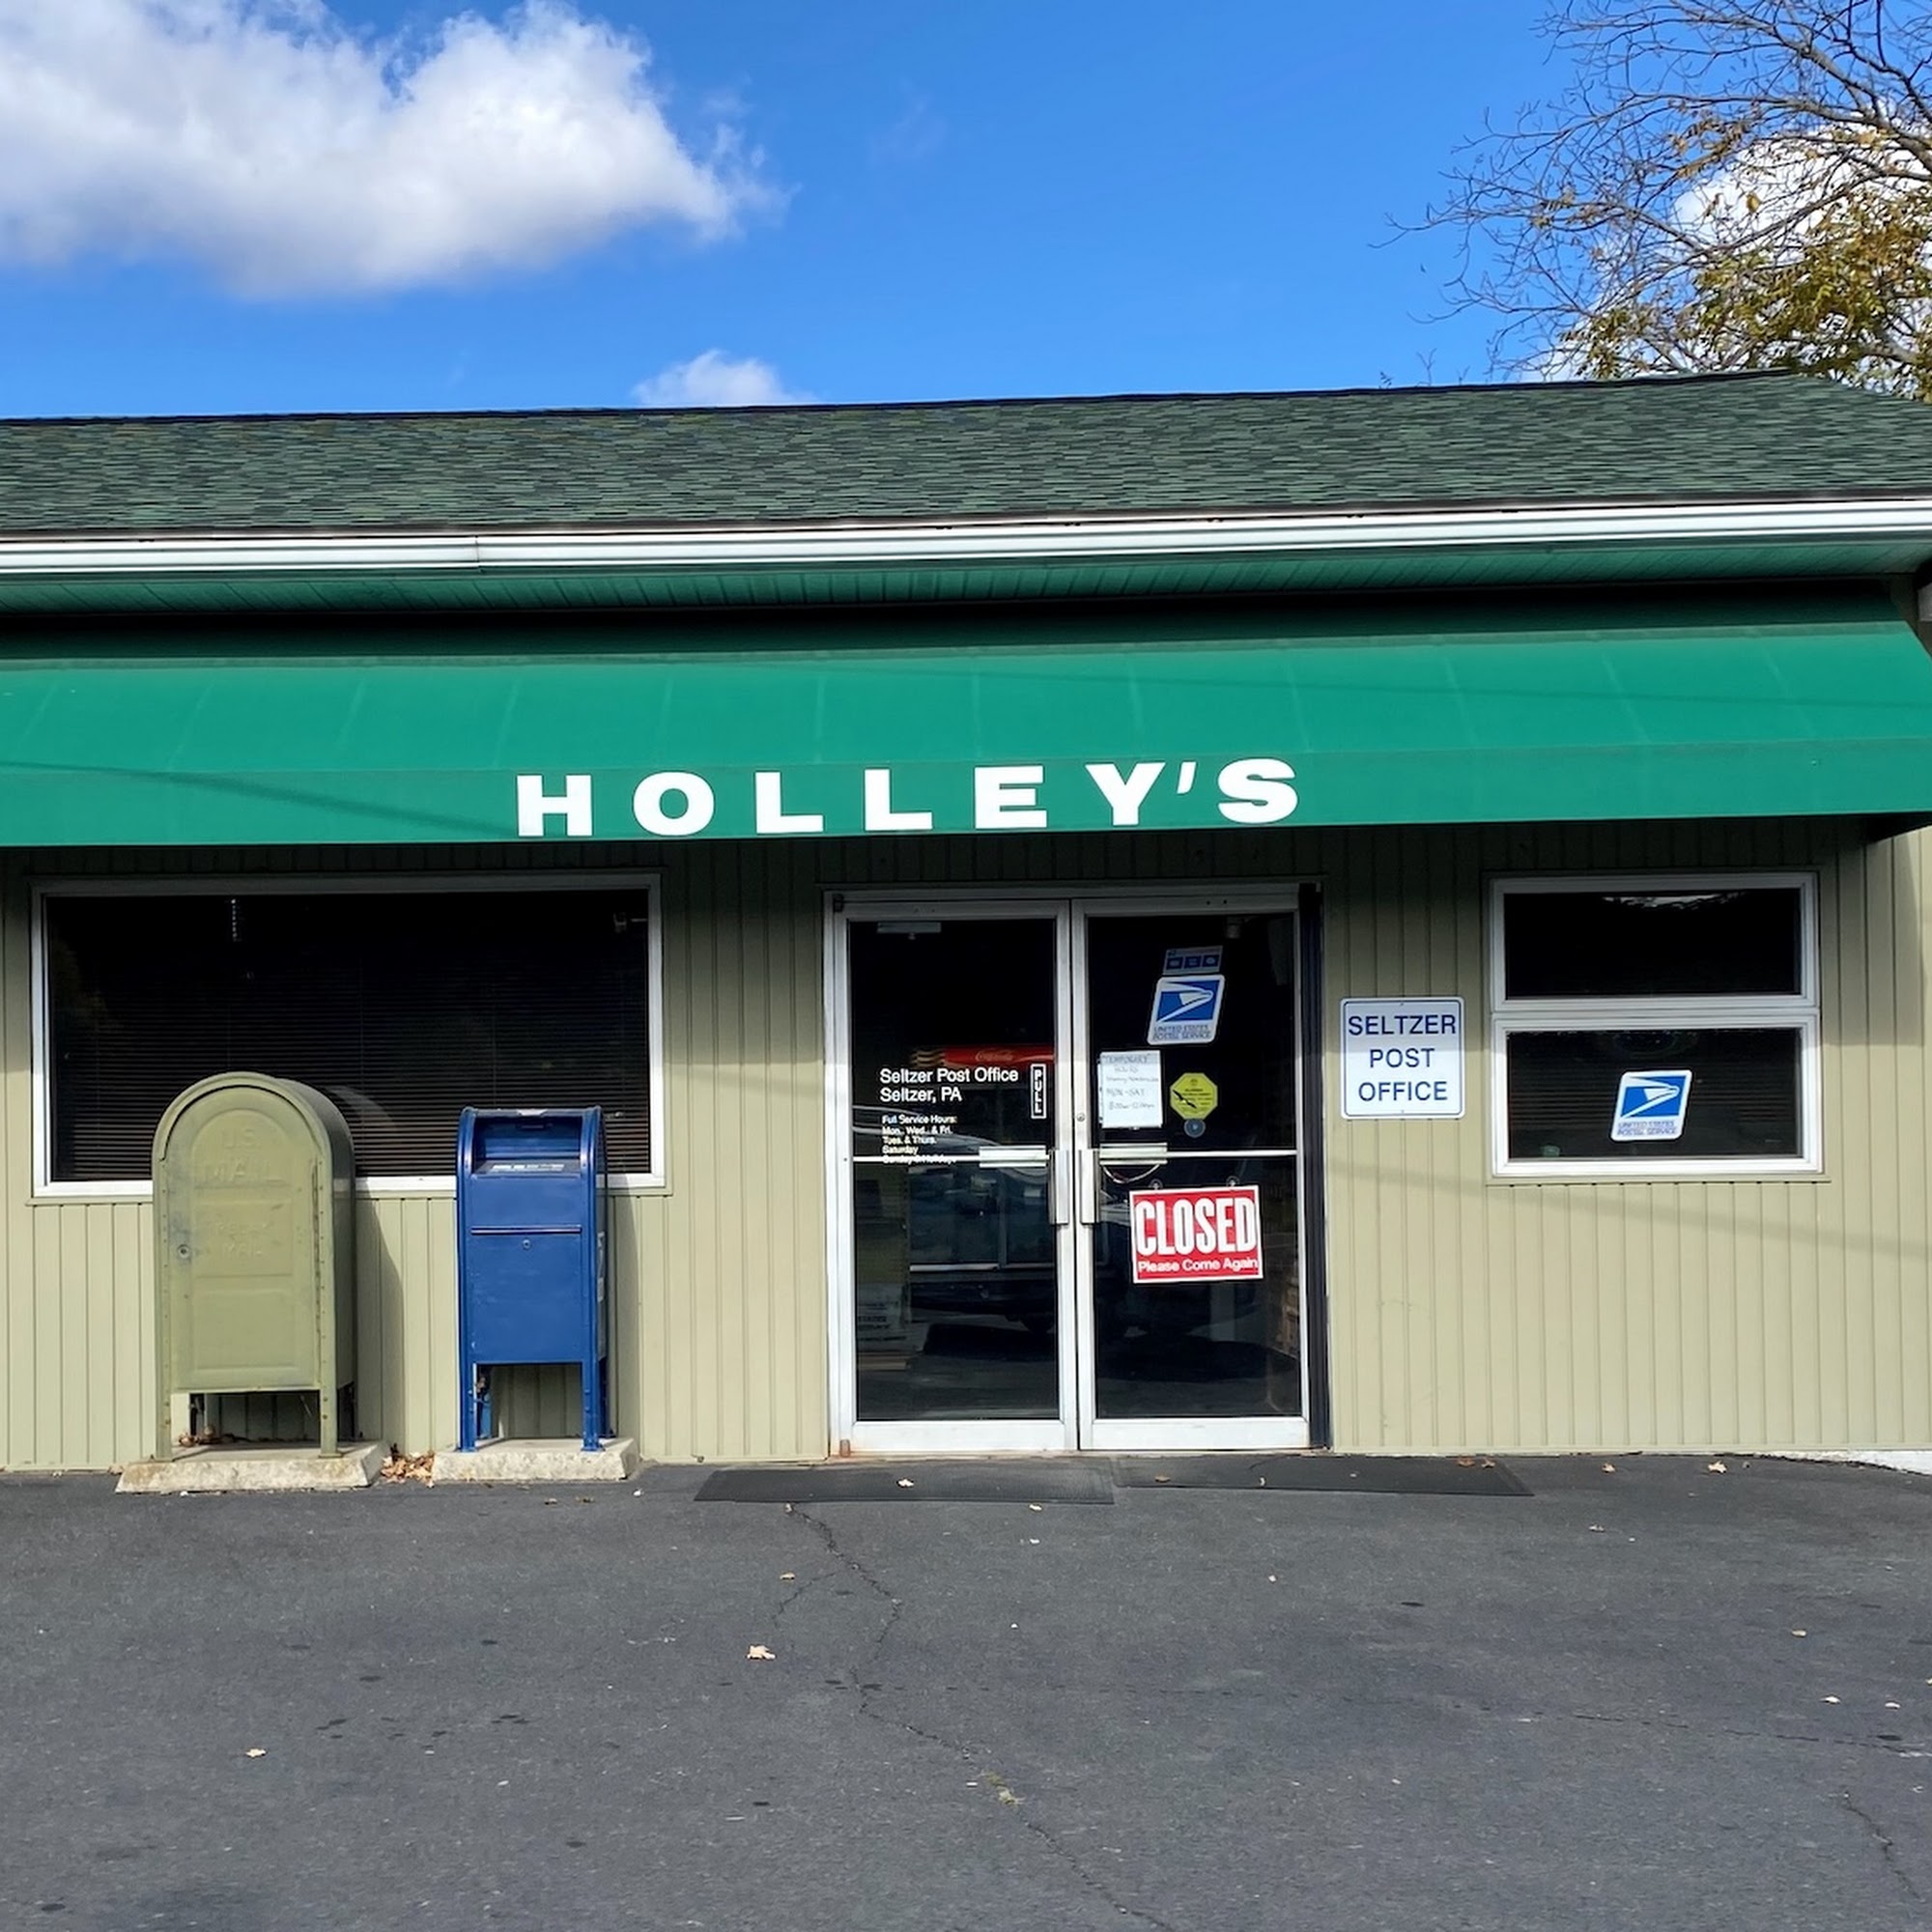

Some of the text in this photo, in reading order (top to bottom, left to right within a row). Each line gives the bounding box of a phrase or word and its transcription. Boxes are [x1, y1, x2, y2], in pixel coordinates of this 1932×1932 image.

[516, 757, 1299, 838] HOLLEY'S
[1348, 1014, 1457, 1037] SELTZER
[1369, 1047, 1435, 1068] POST
[879, 1066, 1019, 1083] Seltzer Post Office
[879, 1087, 963, 1103] Seltzer, PA
[1034, 1068, 1042, 1114] PULL
[1357, 1080, 1449, 1102] OFFICE
[882, 1115, 897, 1124] Full
[898, 1114, 929, 1124] Service
[931, 1125, 938, 1134] &
[882, 1145, 919, 1154] Saturday
[1135, 1197, 1257, 1257] CLOSED
[1137, 1257, 1259, 1273] Please Come Again
